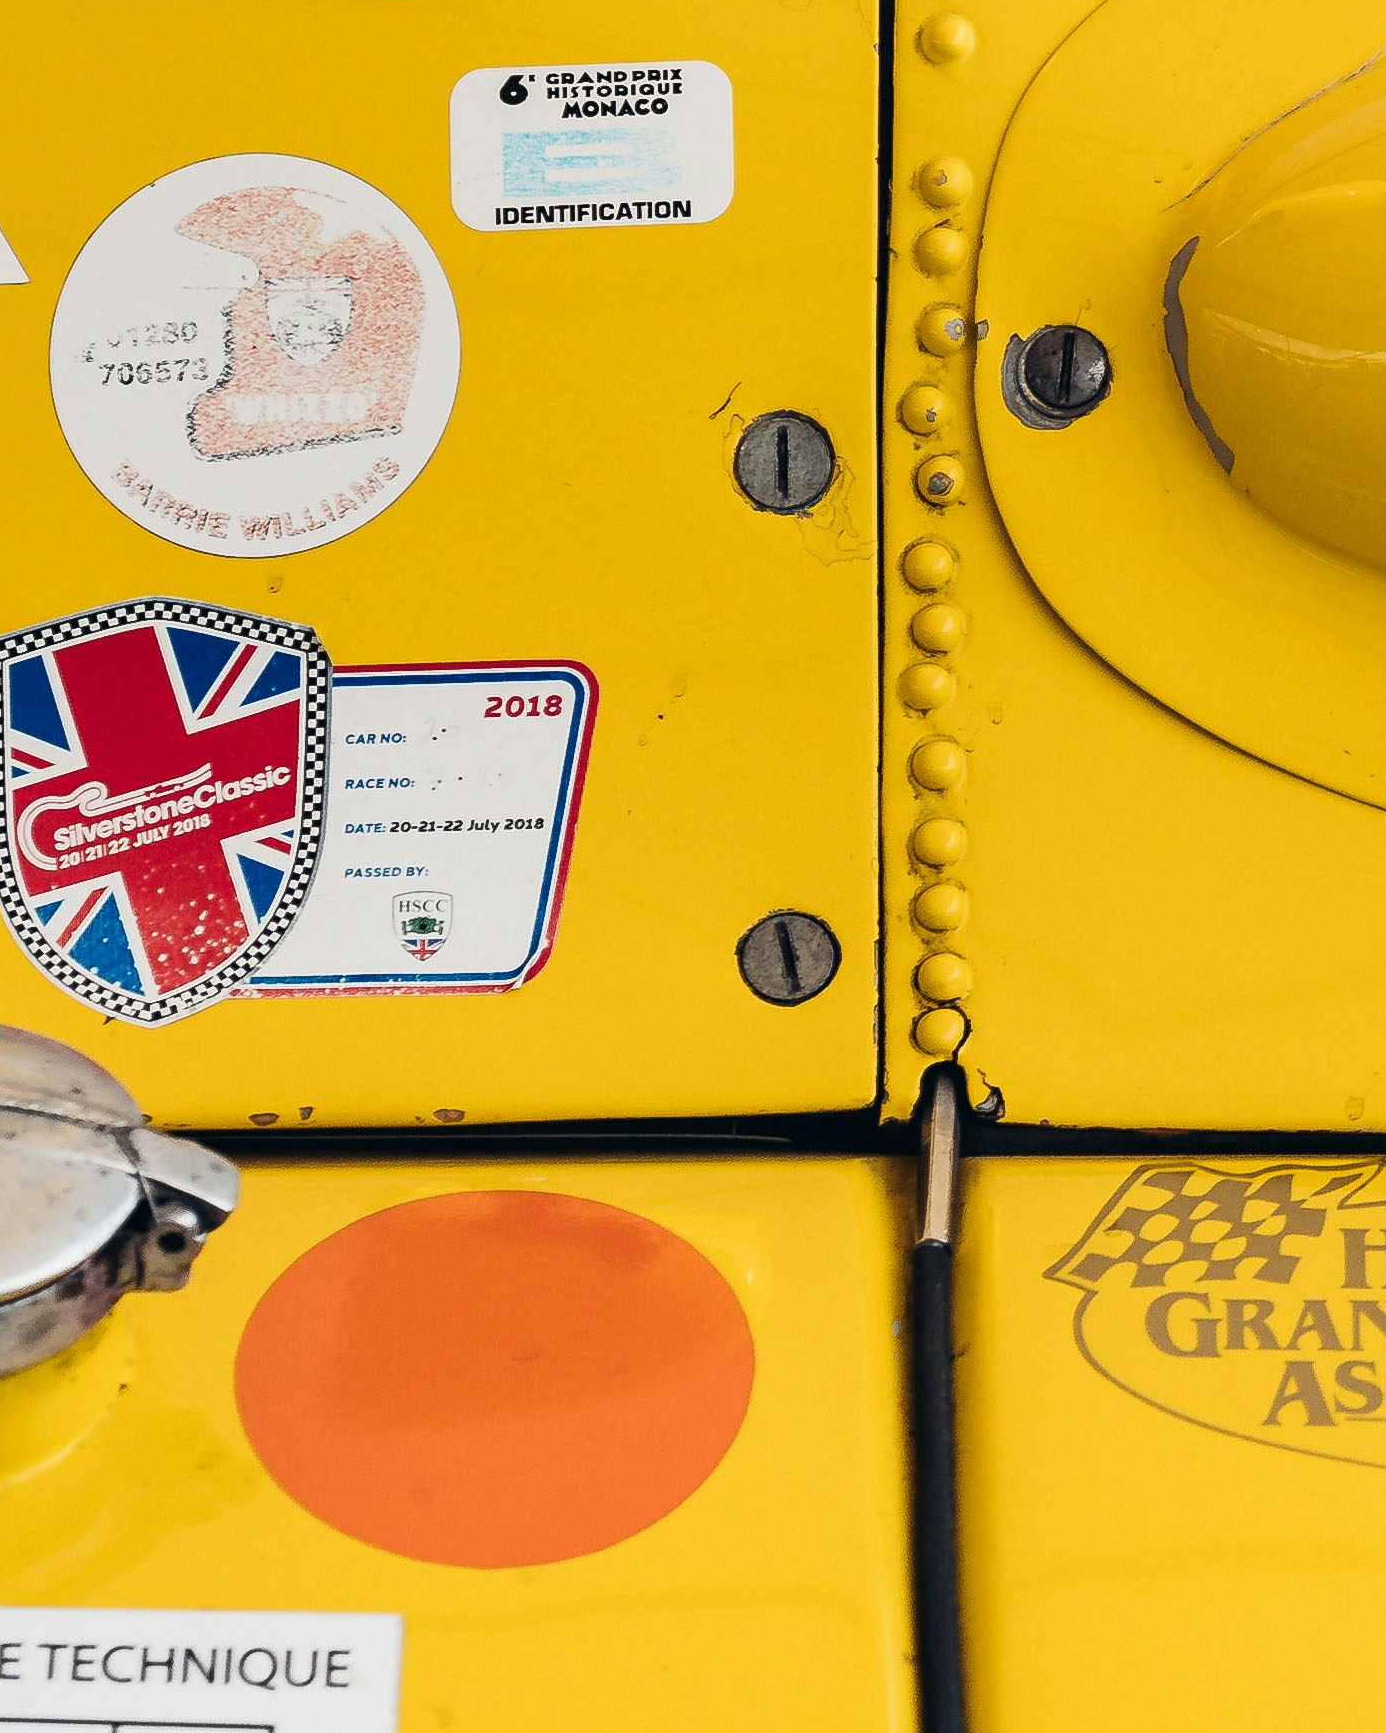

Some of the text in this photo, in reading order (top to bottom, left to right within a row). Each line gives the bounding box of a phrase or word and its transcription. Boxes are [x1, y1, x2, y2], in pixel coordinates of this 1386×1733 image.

[545, 68, 683, 85] GRAND PRIX
[546, 82, 683, 100] HISTORIQUE
[561, 98, 669, 119] MONACO
[495, 200, 692, 226] IDENTIFICATION
[237, 456, 401, 541] WILLIAMS
[483, 694, 563, 718] 2018
[344, 733, 407, 745] CAR NO:
[344, 777, 415, 790] RACE NO:
[133, 824, 170, 848] JULY
[173, 813, 212, 837] 2018
[344, 818, 545, 834] DATE: 20-21-22 July 2018
[344, 865, 430, 878] PASSED BY:
[398, 898, 449, 913] HSCC
[37, 1642, 353, 1689] TECHNIQUE
